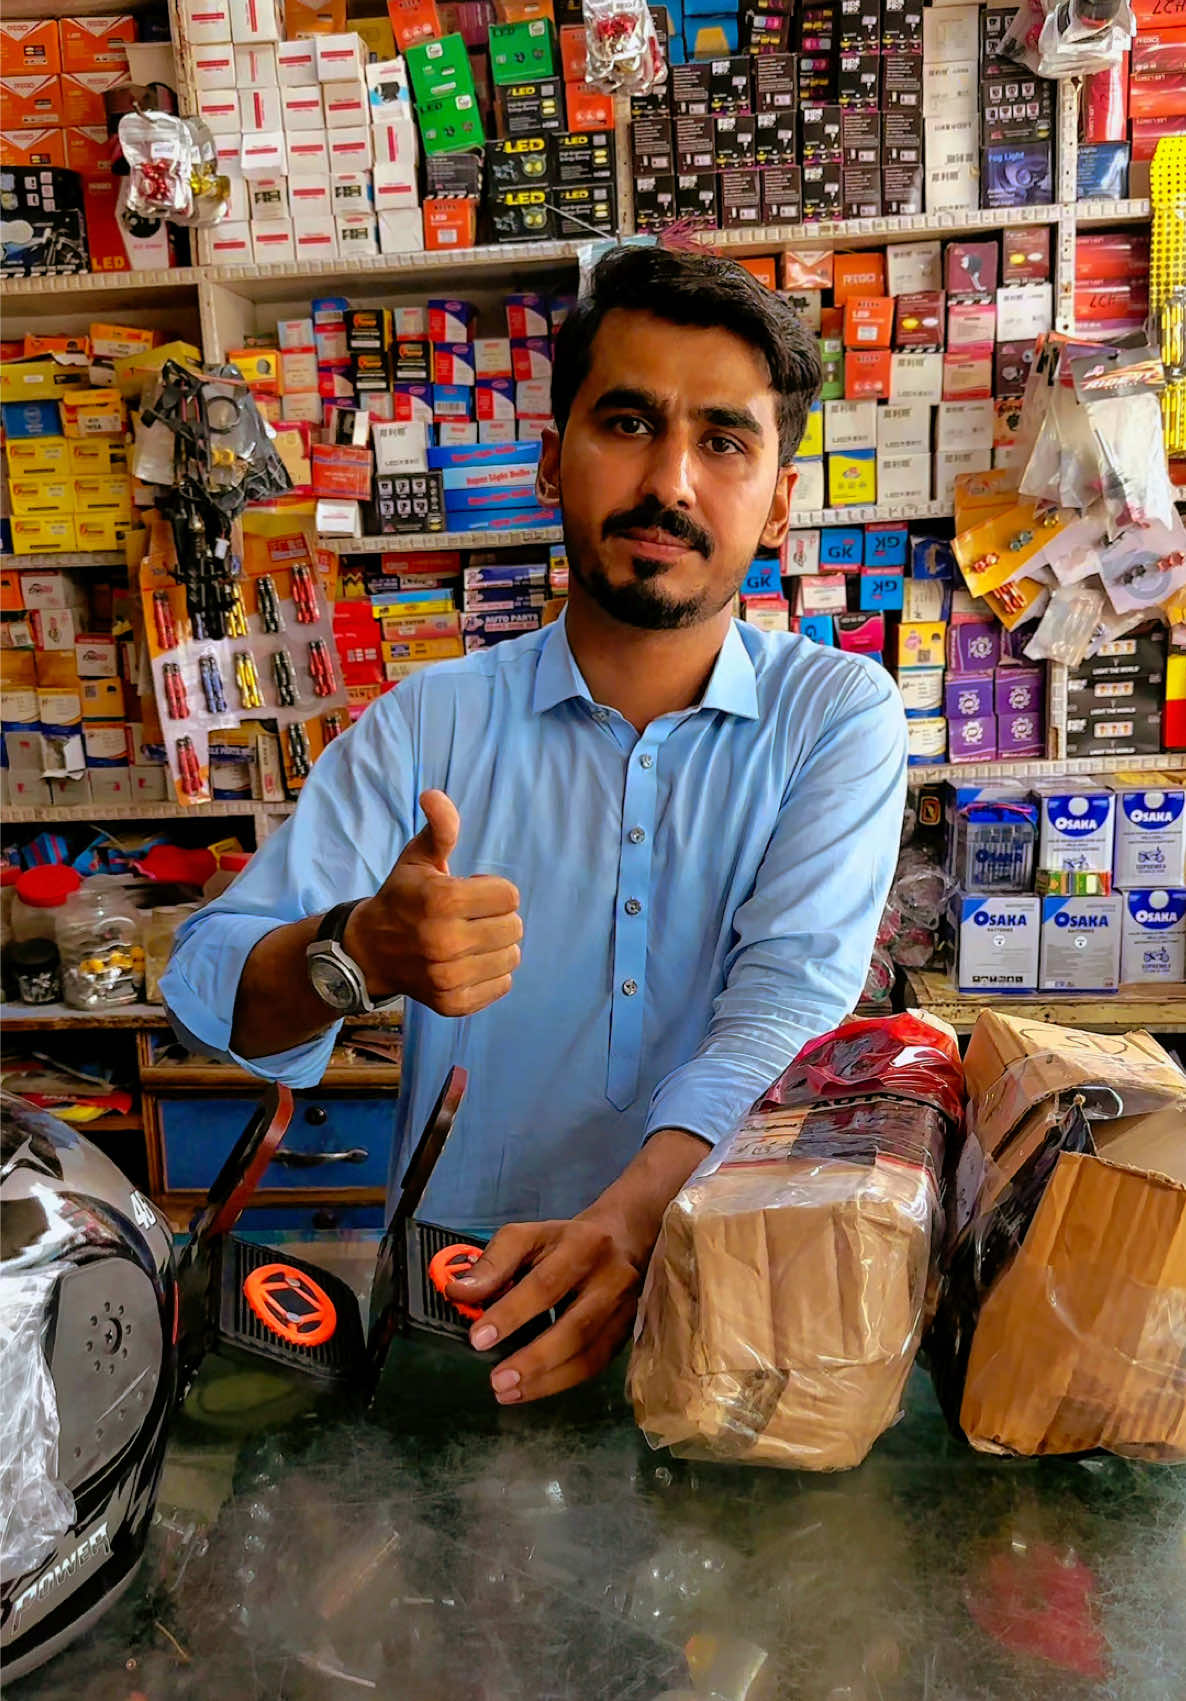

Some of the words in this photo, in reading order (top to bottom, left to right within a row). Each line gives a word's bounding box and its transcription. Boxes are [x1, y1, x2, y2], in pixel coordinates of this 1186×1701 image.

[511, 86, 536, 96] LED
[503, 138, 545, 153] LED
[565, 136, 588, 145] LED
[504, 191, 546, 206] LED
[565, 190, 589, 200] LED
[91, 256, 126, 271] LED
[875, 535, 900, 549] GK
[828, 545, 853, 559] GK
[747, 575, 772, 589] GK
[873, 580, 897, 593] GK
[485, 615, 510, 624] AUTO
[511, 613, 539, 623] PARTS
[1130, 808, 1173, 823] OSAKA
[1055, 816, 1098, 831] OSAKA
[974, 911, 1027, 927] OSAKA
[1054, 911, 1109, 928] OSAKA
[1135, 909, 1177, 923] OSAKA
[11, 1521, 114, 1636] POWER
